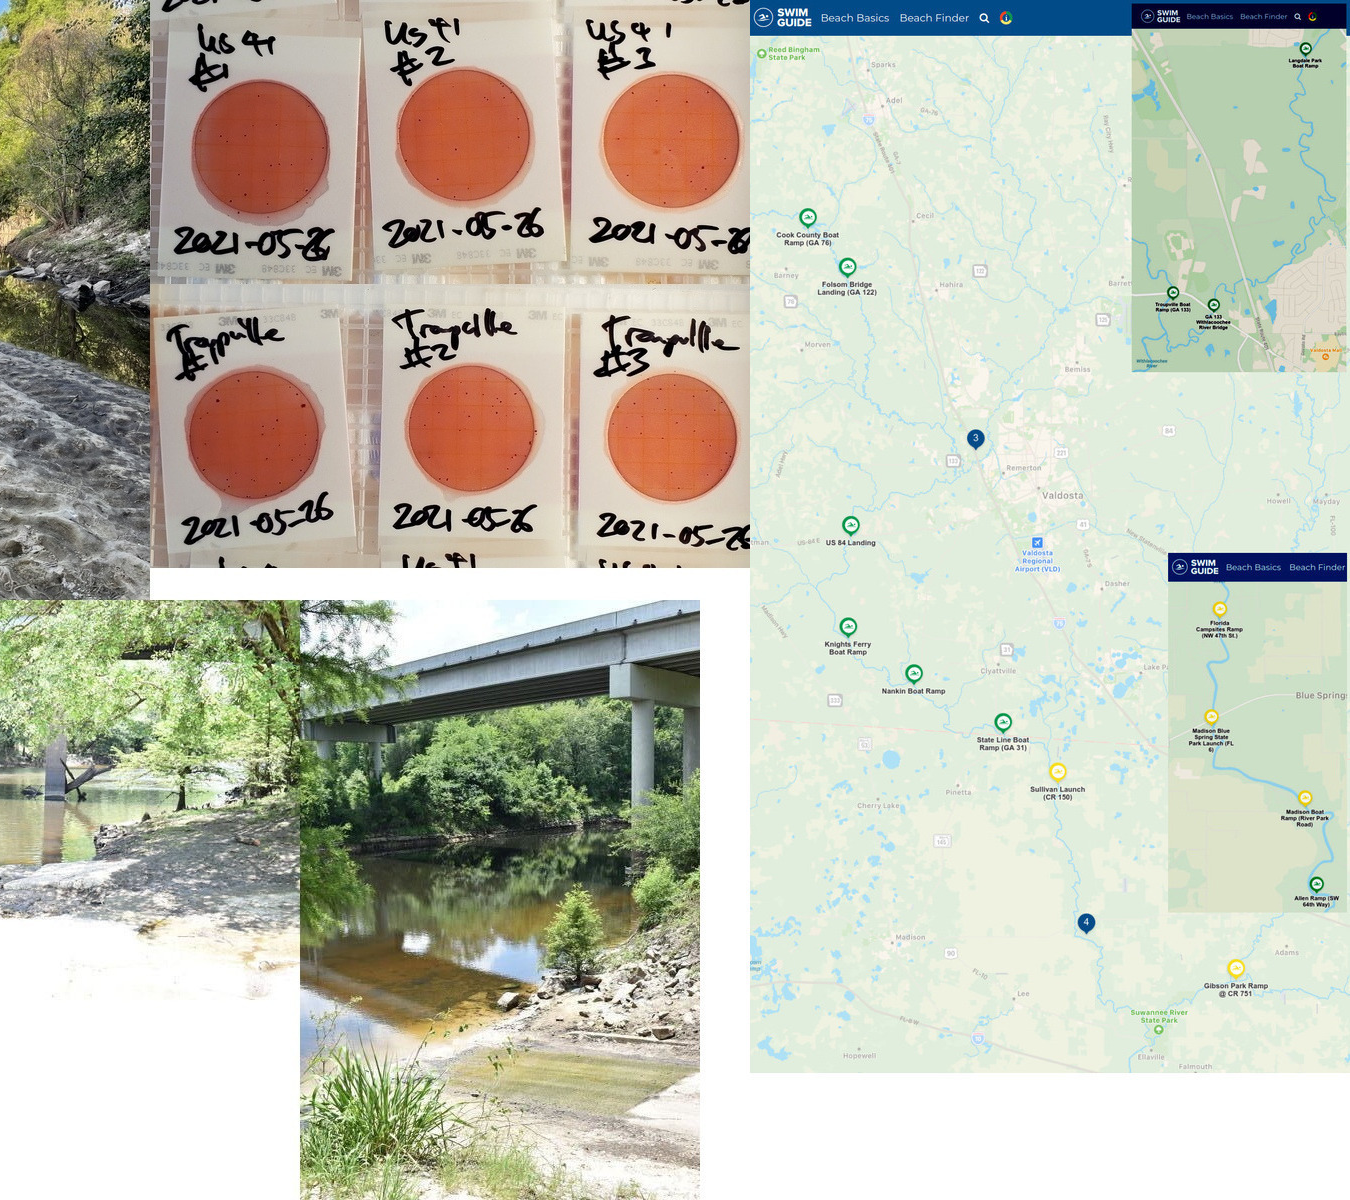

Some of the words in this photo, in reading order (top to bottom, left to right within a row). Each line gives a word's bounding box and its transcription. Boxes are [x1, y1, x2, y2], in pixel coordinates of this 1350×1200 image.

[777, 8, 808, 17] SWIM
[821, 13, 854, 23] Beach
[856, 13, 889, 23] Basics
[900, 13, 932, 23] Beach
[935, 13, 969, 23] Finder
[777, 18, 812, 27] GUIDE
[788, 46, 820, 55] Bingham
[871, 61, 896, 69] Sparks
[795, 232, 821, 241] County
[784, 239, 803, 248] Ramp
[806, 239, 818, 247] (GA
[821, 239, 832, 247] 76)
[822, 281, 847, 289] Folsom
[849, 281, 873, 290] Bridge
[939, 281, 964, 289] Hahira
[817, 289, 845, 297] Landing
[847, 289, 860, 297] (GA
[862, 289, 877, 297] 122)
[1042, 491, 1084, 501] Valdosta
[848, 539, 876, 547] Landing
[1022, 549, 1053, 557] Valdosta
[1022, 557, 1053, 566] Regional
[1014, 565, 1039, 574] Airport
[1041, 565, 1061, 574] (VLD)
[824, 641, 850, 649] Knights
[852, 641, 871, 649] Ferry
[847, 649, 867, 657] Ramp
[926, 688, 946, 696] Ramp
[979, 744, 999, 752] Ramp
[1001, 744, 1014, 752] (GA
[1016, 744, 1027, 752] 31)
[1204, 982, 1228, 990] Gibson
[1230, 982, 1246, 990] Park
[1248, 982, 1268, 990] Ramp
[1219, 990, 1226, 998] @
